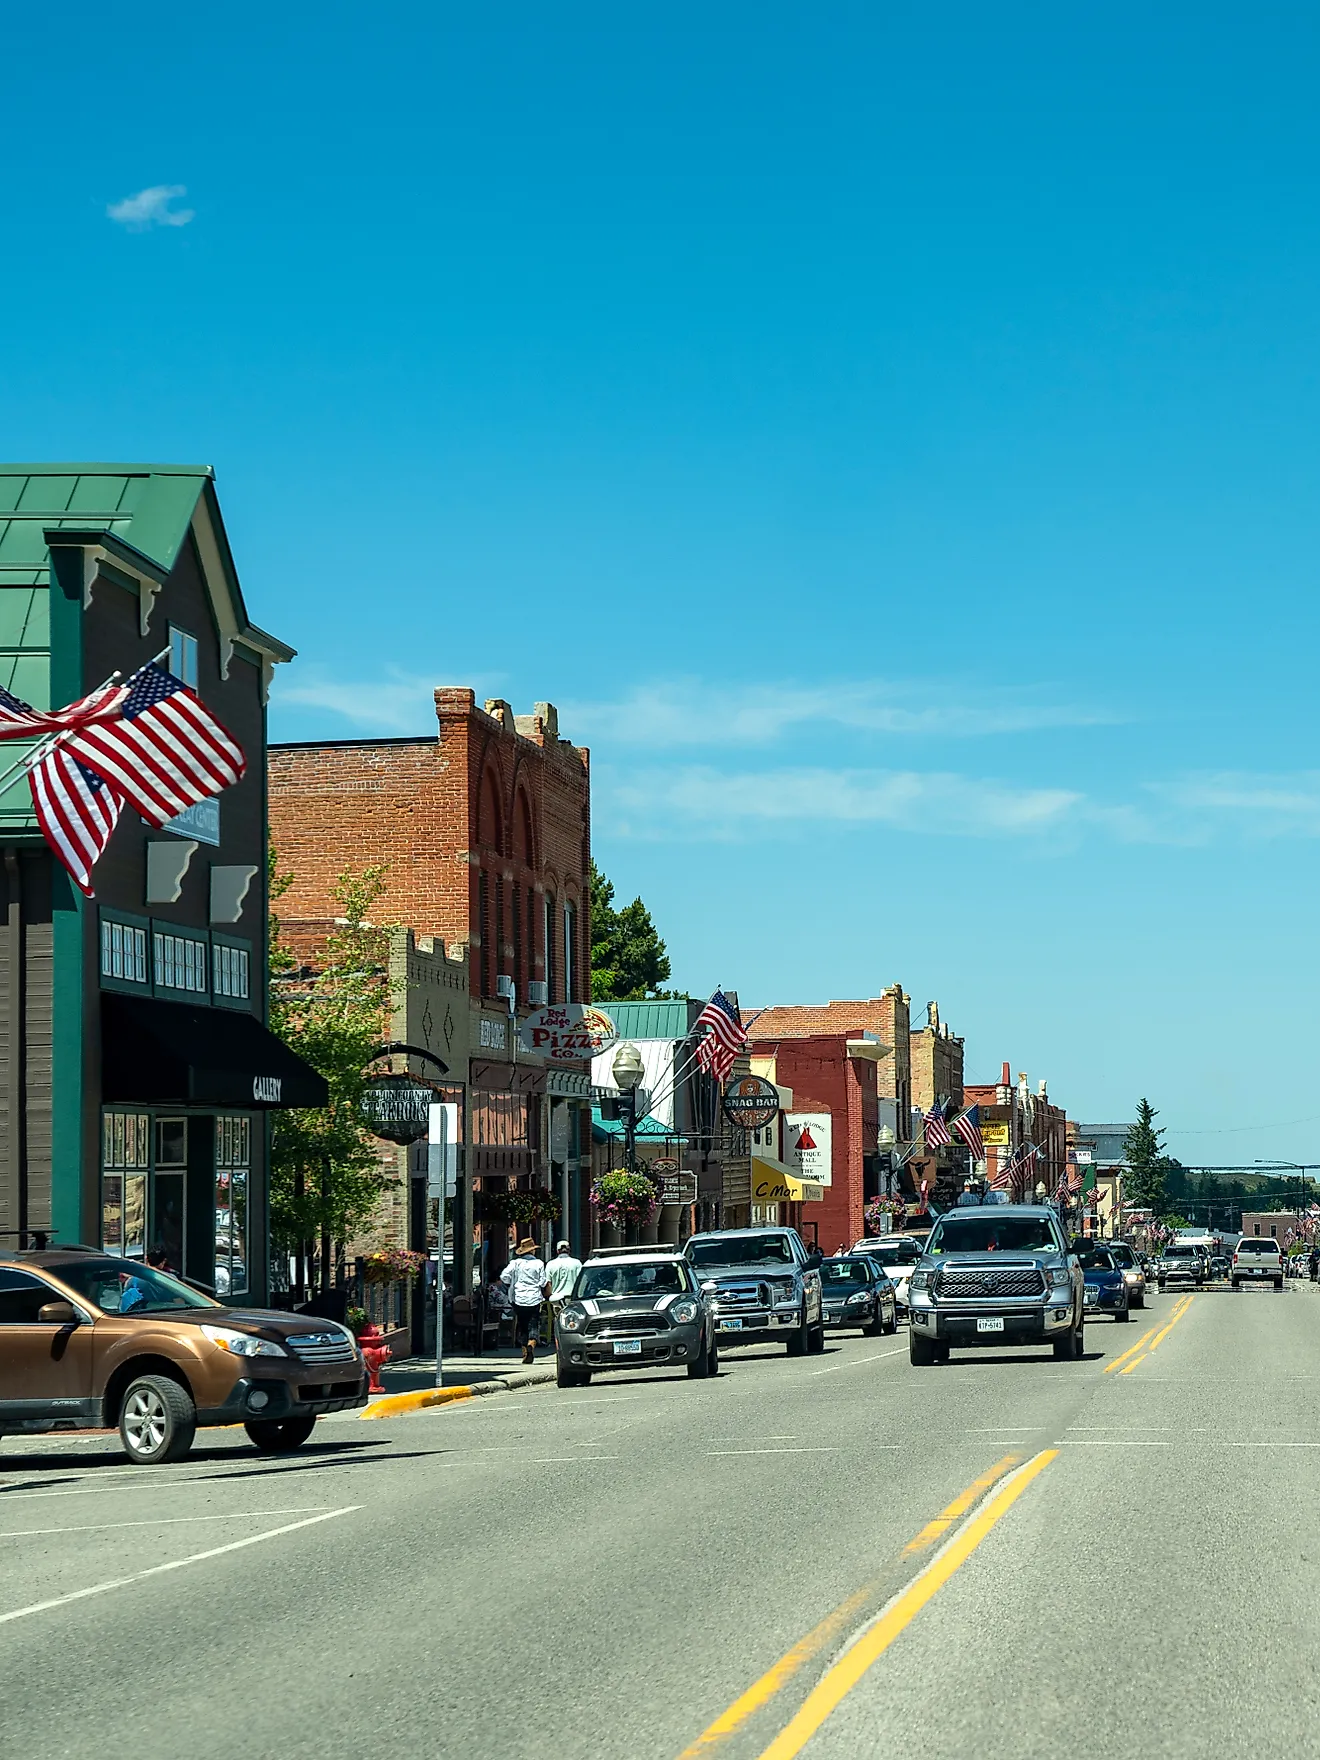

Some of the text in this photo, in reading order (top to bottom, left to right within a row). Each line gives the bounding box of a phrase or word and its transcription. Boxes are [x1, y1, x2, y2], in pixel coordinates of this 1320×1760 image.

[546, 1008, 567, 1018] Red
[540, 1016, 571, 1028] Lodge
[253, 1076, 282, 1102] GALLERY
[725, 1098, 778, 1108] SNAG BAR
[360, 1100, 430, 1122] STEAKHOUS
[755, 1181, 769, 1198] C
[769, 1184, 798, 1197] Mor
